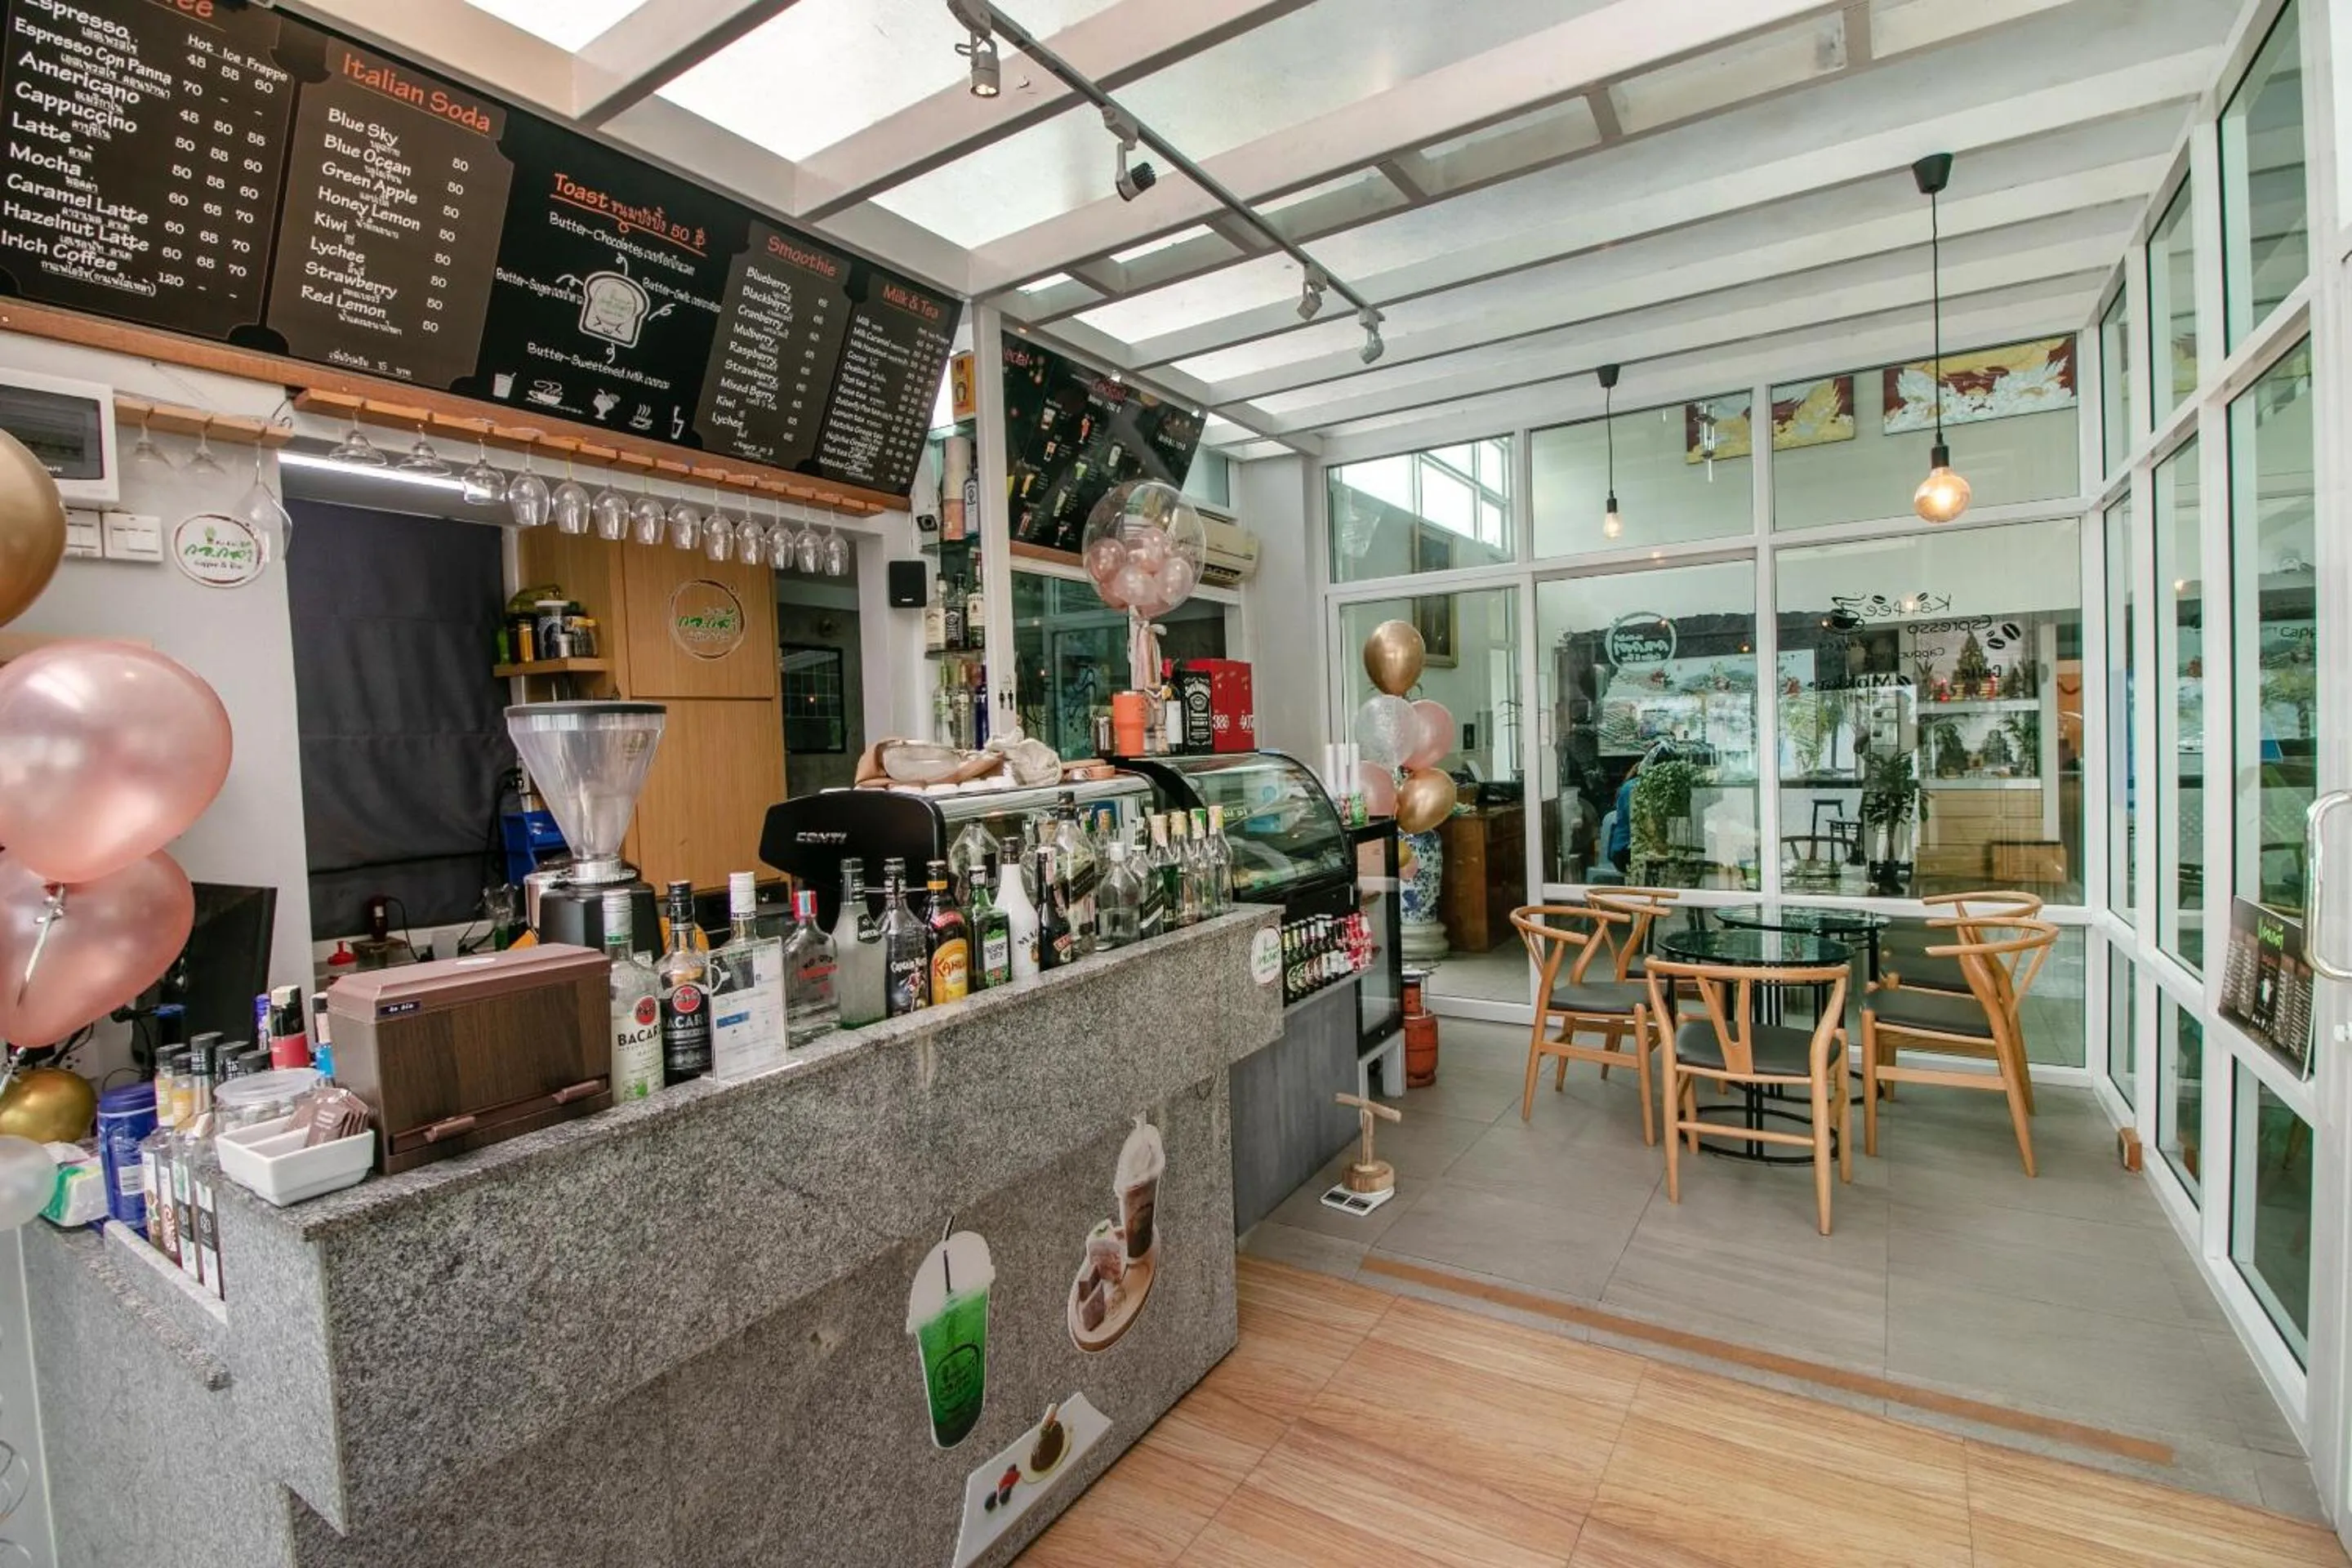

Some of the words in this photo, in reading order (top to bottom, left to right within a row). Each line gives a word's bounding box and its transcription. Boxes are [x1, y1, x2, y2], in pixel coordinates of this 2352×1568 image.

[16, 16, 92, 56] Espresso
[96, 47, 125, 68] Con
[128, 58, 172, 85] Panna
[188, 33, 213, 52] Hot
[223, 47, 241, 64] Ice
[247, 56, 287, 82] Frappe
[19, 51, 140, 104] Americano
[183, 80, 203, 96] 70
[342, 53, 424, 105] Italian
[430, 91, 490, 131] Soda
[16, 82, 137, 132] Cappuccino
[12, 111, 72, 143] Latte
[328, 107, 364, 132] Blue
[368, 123, 399, 147] Sky
[10, 142, 82, 176] Mocha
[323, 134, 361, 158] Blue
[363, 149, 412, 176] Ocean
[322, 161, 371, 188] Green
[373, 179, 418, 204] Apple
[7, 174, 91, 209] Caramel
[96, 198, 149, 225] Latte
[168, 192, 189, 207] 60
[236, 209, 254, 224] 70
[318, 185, 368, 218] Honey
[372, 204, 421, 230] Lemon
[555, 172, 609, 208] Toast
[670, 223, 689, 242] 50
[3, 200, 94, 237] Hazelnut
[99, 225, 149, 252] Latte
[314, 211, 347, 233] Kiwi
[549, 211, 644, 258] Butter-Chocolates
[1, 229, 47, 255] Irich
[53, 244, 118, 270] Coffee
[232, 239, 250, 253] 70
[310, 235, 365, 263] Lychee
[767, 235, 836, 277] Smoothie
[158, 272, 185, 287] 120
[229, 264, 247, 277] 70
[305, 261, 398, 300] Strawberry
[746, 265, 791, 293] Blueberry
[301, 285, 333, 305] Red
[336, 294, 386, 318] Lemon
[742, 284, 791, 314] Blackberry
[883, 284, 908, 306] Milk
[909, 295, 919, 310] &
[920, 300, 939, 319] Tea
[733, 322, 775, 345] Mulberry
[737, 304, 783, 330] Cranberry
[728, 341, 777, 366] Raspberry
[724, 359, 778, 385] Strawberry
[716, 394, 736, 408] Kiwi
[720, 376, 749, 394] Mixed
[749, 385, 775, 403] Berry
[711, 412, 744, 428] Lychee
[617, 1023, 661, 1046] BACAR
